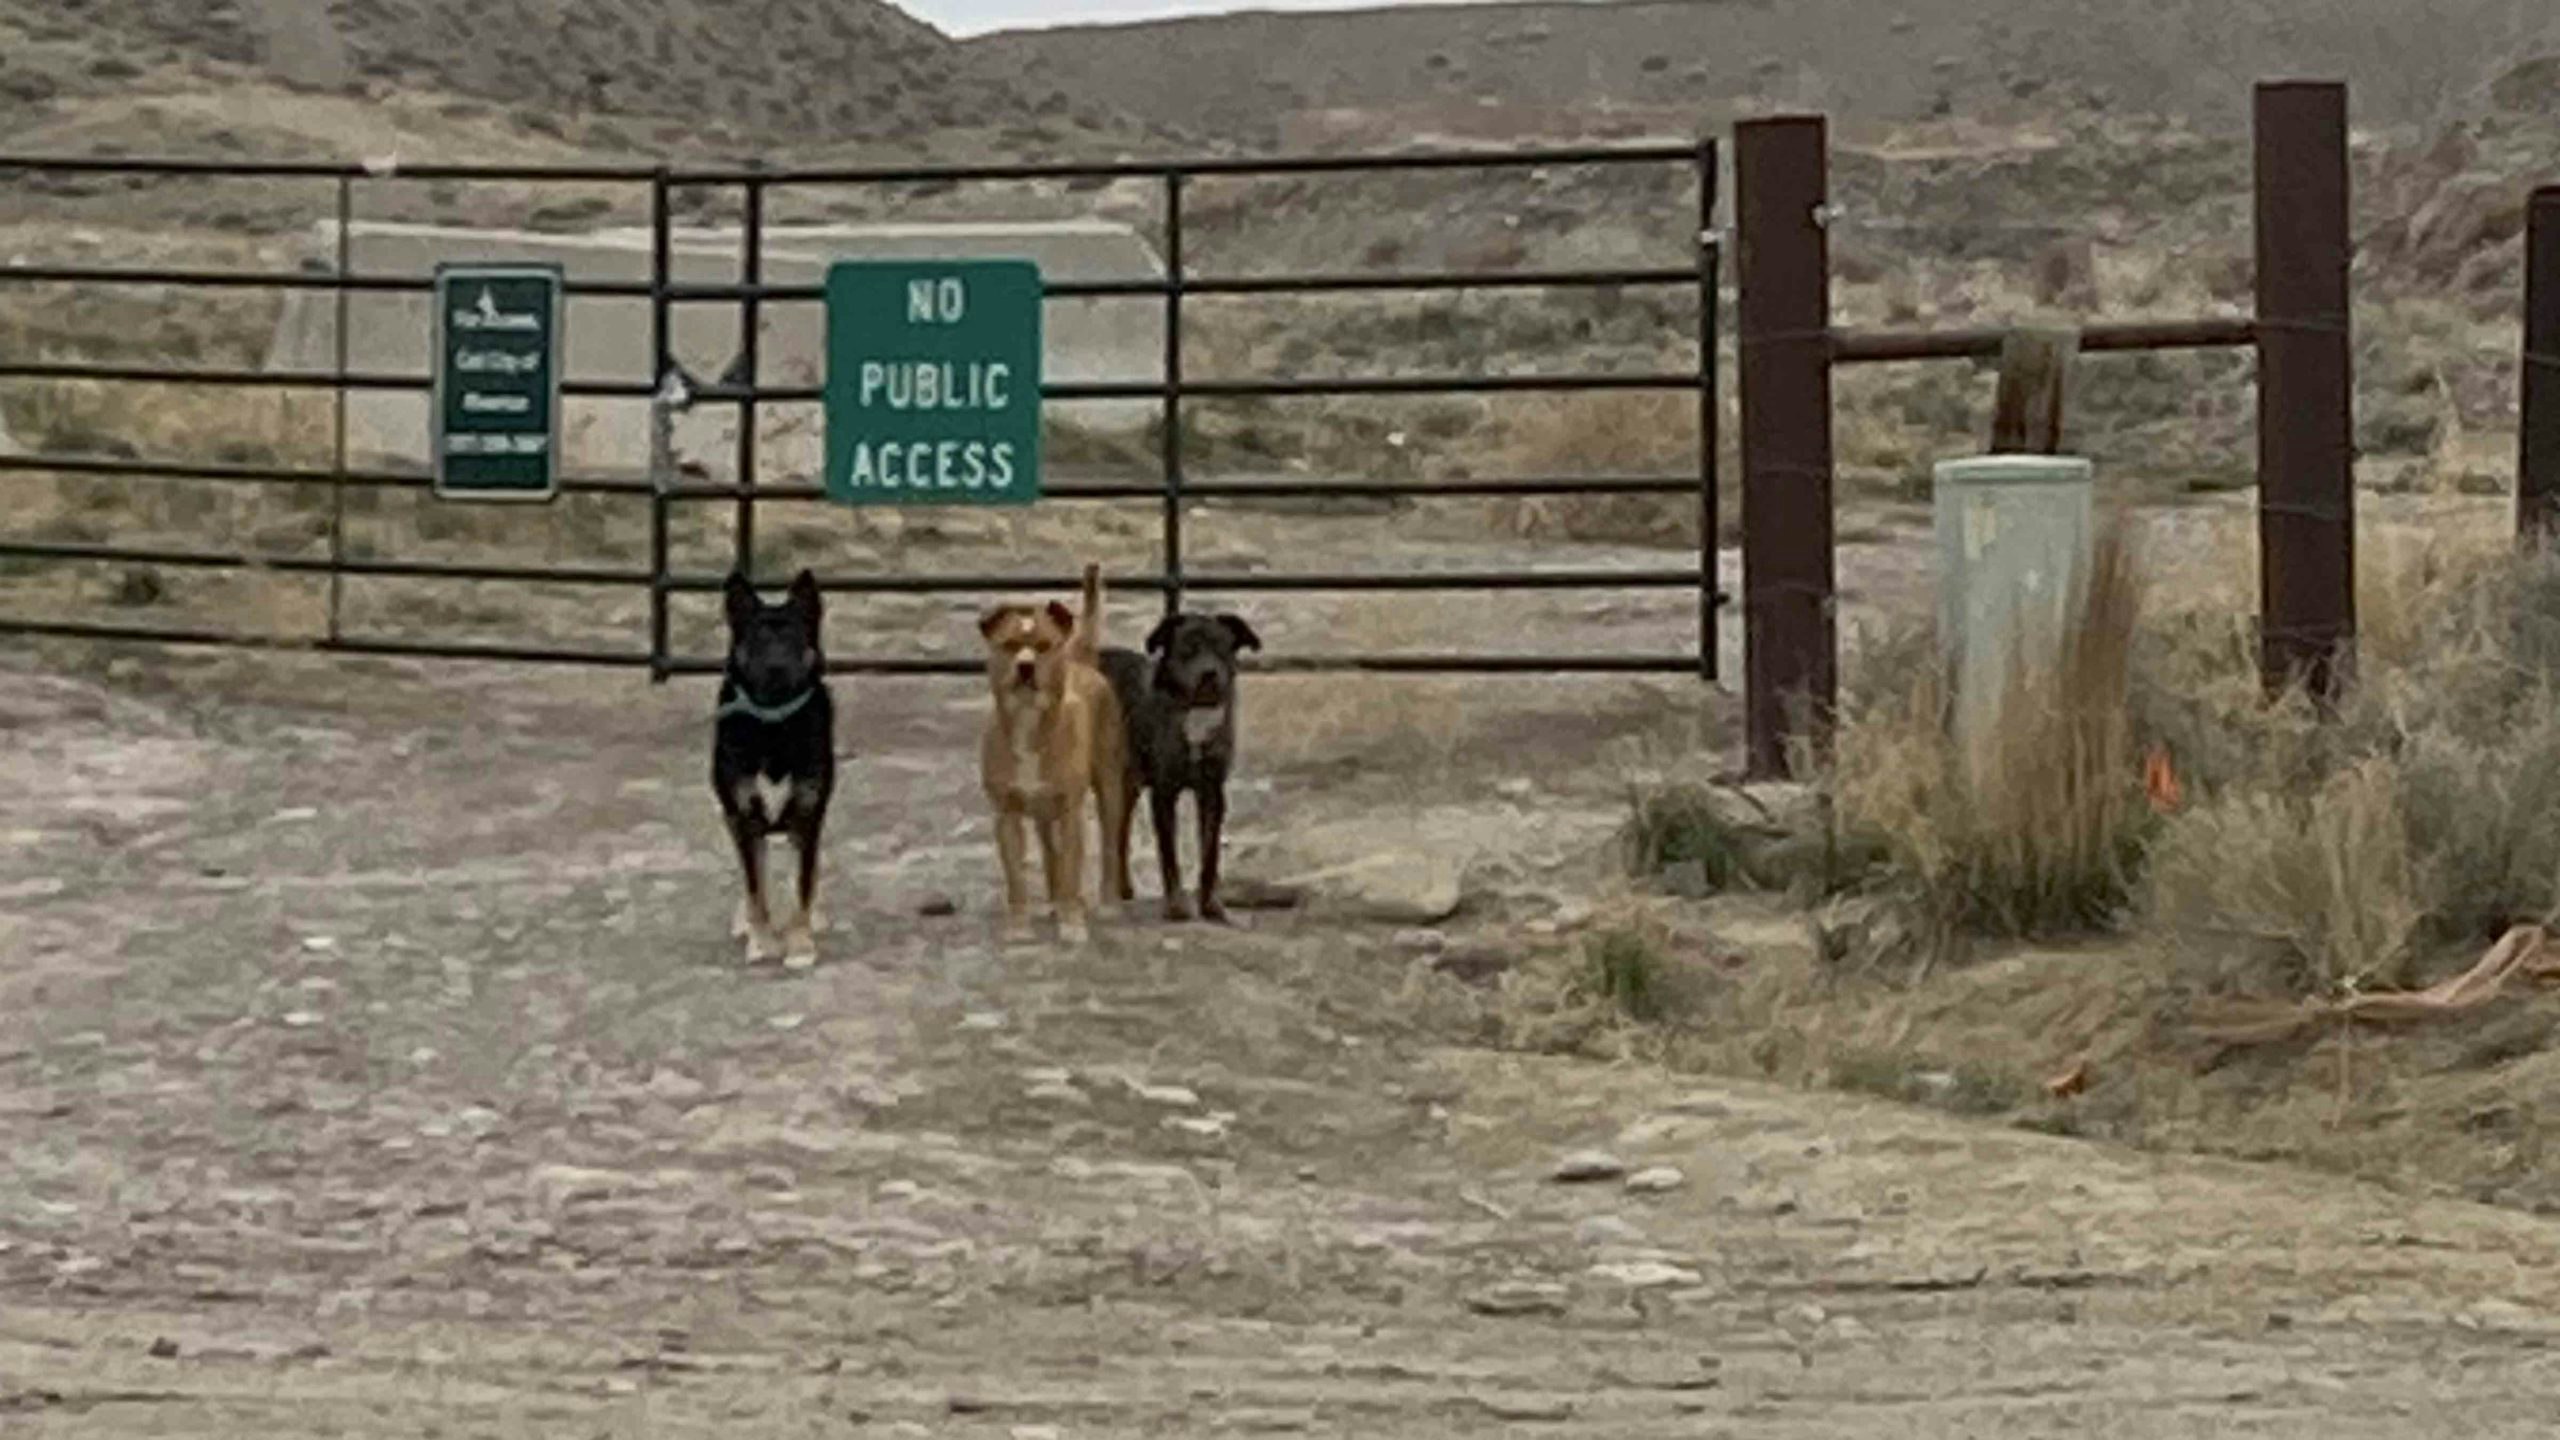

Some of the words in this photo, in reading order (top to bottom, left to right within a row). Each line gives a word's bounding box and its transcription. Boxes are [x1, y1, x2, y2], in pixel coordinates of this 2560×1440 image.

[908, 277, 964, 323] NO
[859, 363, 1010, 409] PUBLIC
[850, 441, 1014, 488] ACCESS
